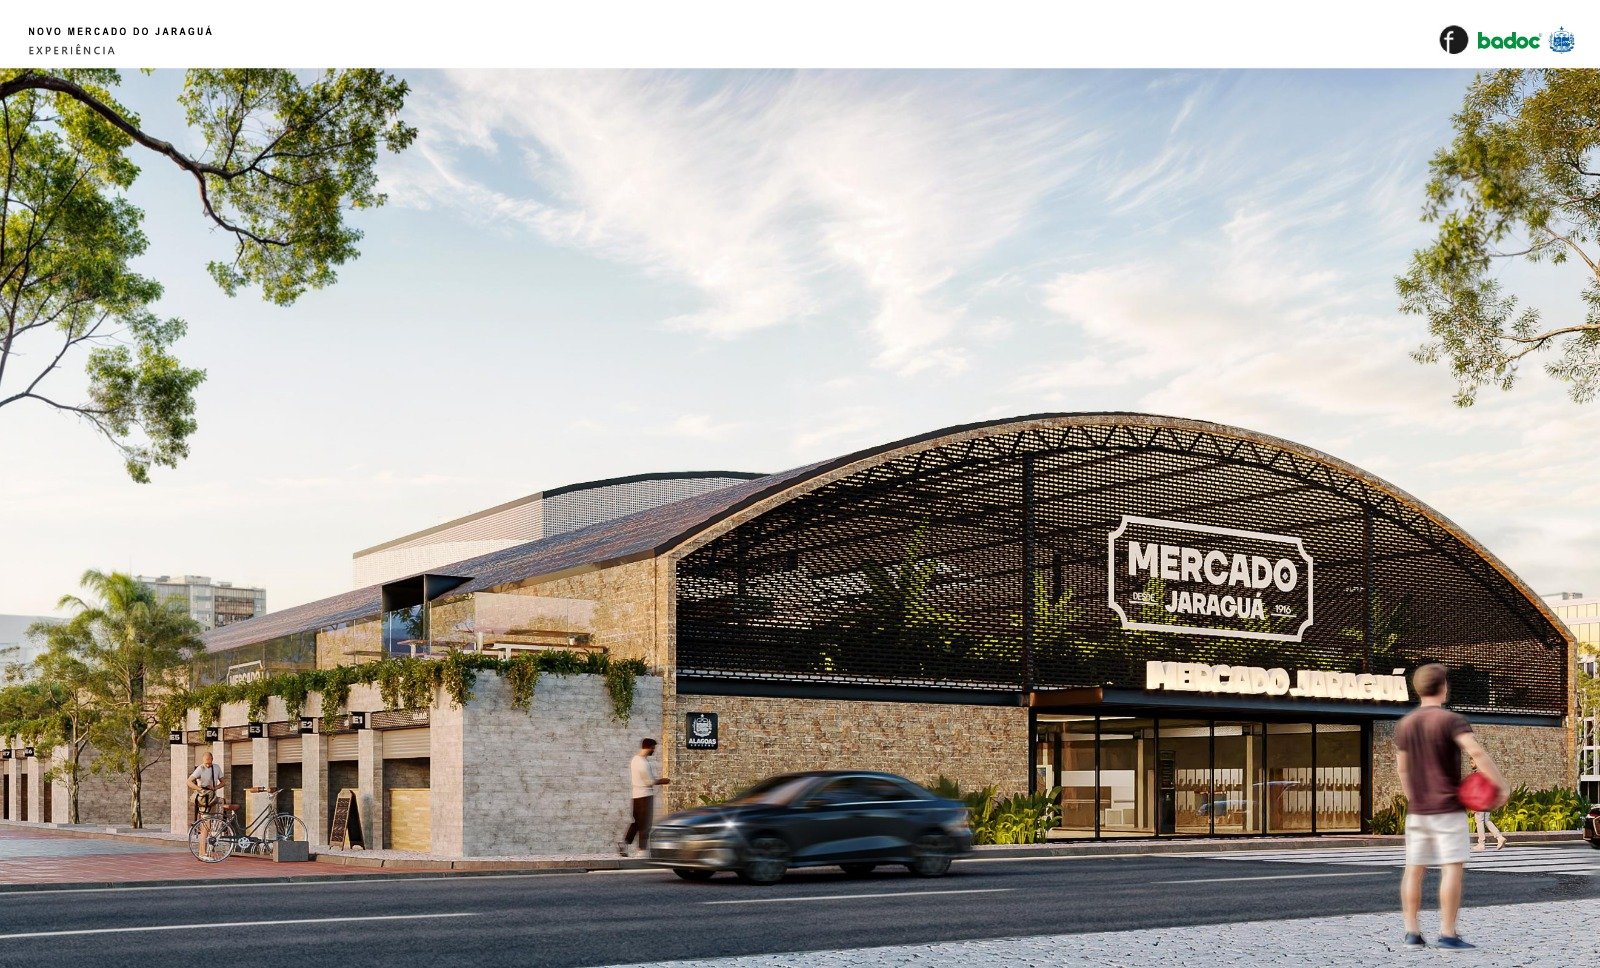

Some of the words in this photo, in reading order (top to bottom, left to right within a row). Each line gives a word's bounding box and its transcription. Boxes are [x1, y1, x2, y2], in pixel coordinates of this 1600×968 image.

[1128, 541, 1298, 592] MERCADO
[1132, 592, 1157, 602] DESDE
[1165, 591, 1265, 620] JARAGUÁ
[1275, 604, 1292, 615] 1916
[1146, 660, 1290, 696] MERCADO
[1289, 668, 1410, 702] JARAGUÁ
[352, 715, 363, 724] E1
[249, 726, 261, 734] E3
[301, 721, 313, 729] E2
[206, 730, 218, 738] E4
